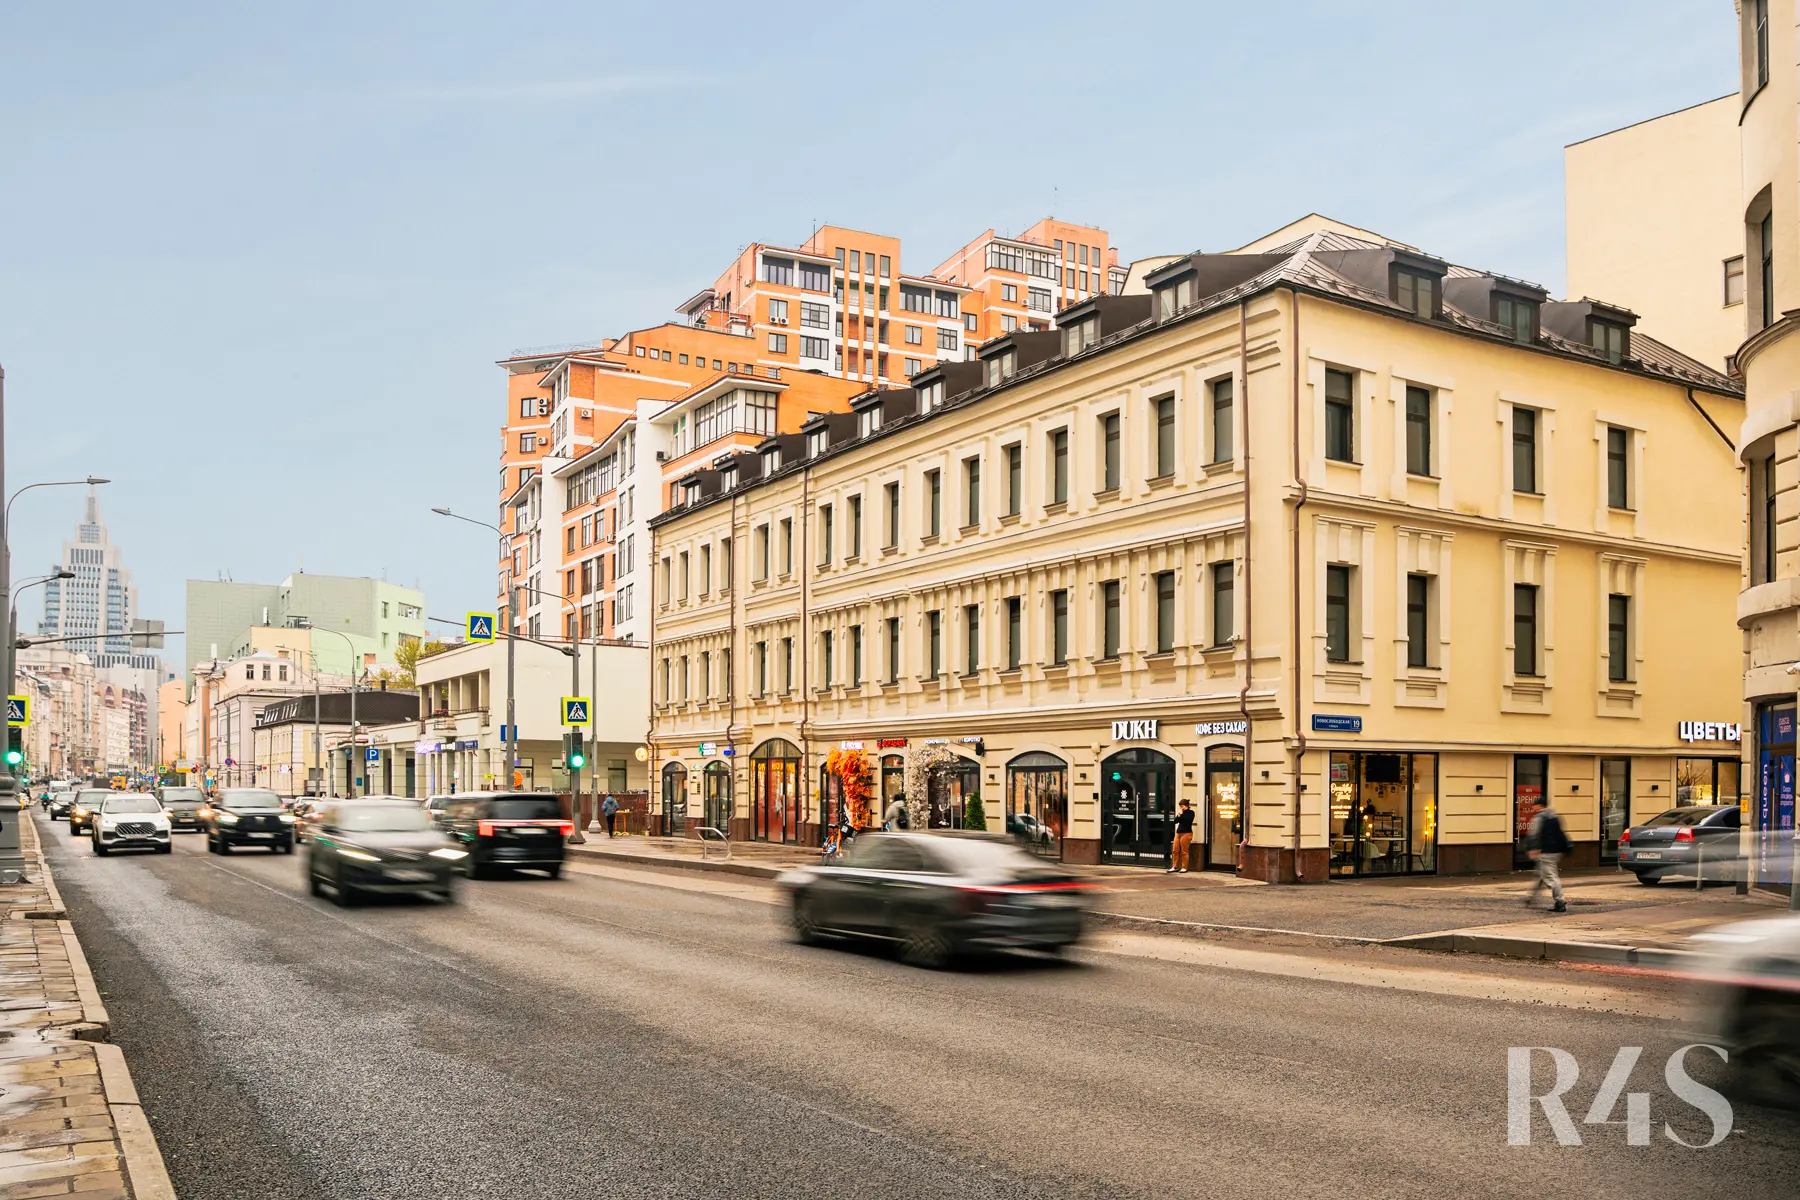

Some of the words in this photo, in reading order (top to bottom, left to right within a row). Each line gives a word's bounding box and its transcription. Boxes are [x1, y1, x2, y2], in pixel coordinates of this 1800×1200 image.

[1111, 719, 1157, 740] DUKH
[1195, 723, 1212, 734] КОФЕ
[1212, 722, 1225, 734] БЕЗ
[1225, 721, 1246, 733] САХАР
[1353, 720, 1360, 728] 19
[1680, 721, 1741, 743] ЦВЕТЫ
[1517, 795, 1541, 804] АРЕНД
